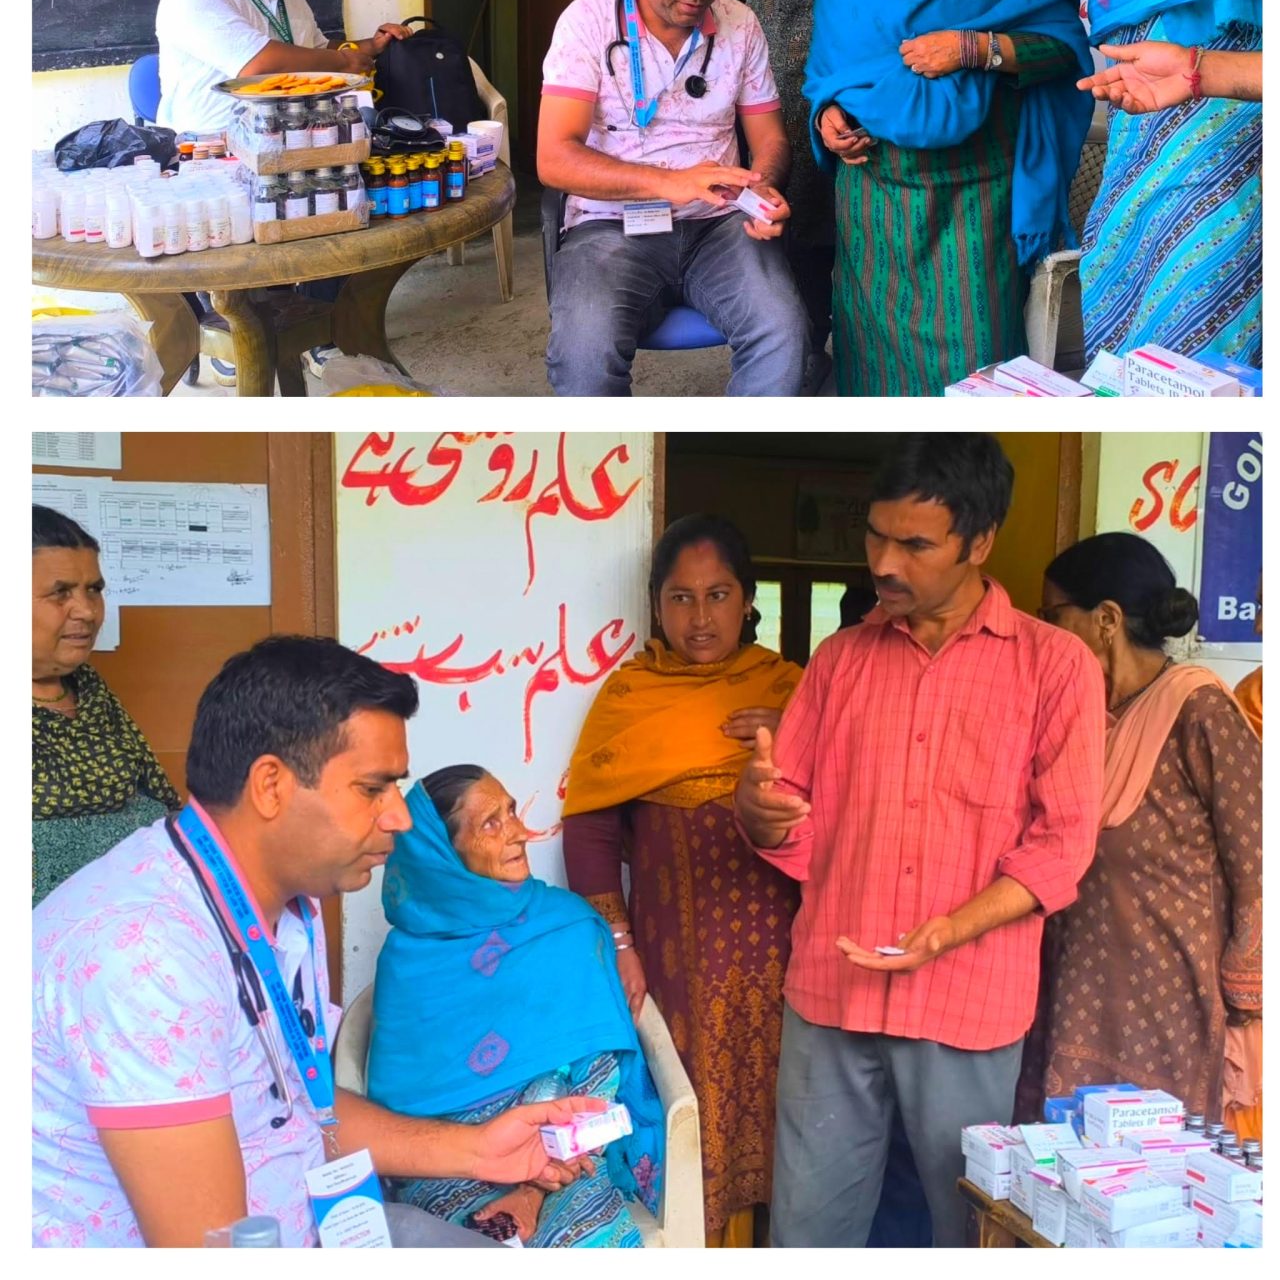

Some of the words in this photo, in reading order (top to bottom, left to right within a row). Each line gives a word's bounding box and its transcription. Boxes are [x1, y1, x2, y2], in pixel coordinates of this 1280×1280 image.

[1127, 357, 1206, 397] Paracetamol
[1112, 1105, 1179, 1119] Paracetamol
[1112, 1117, 1144, 1128] Tablets
